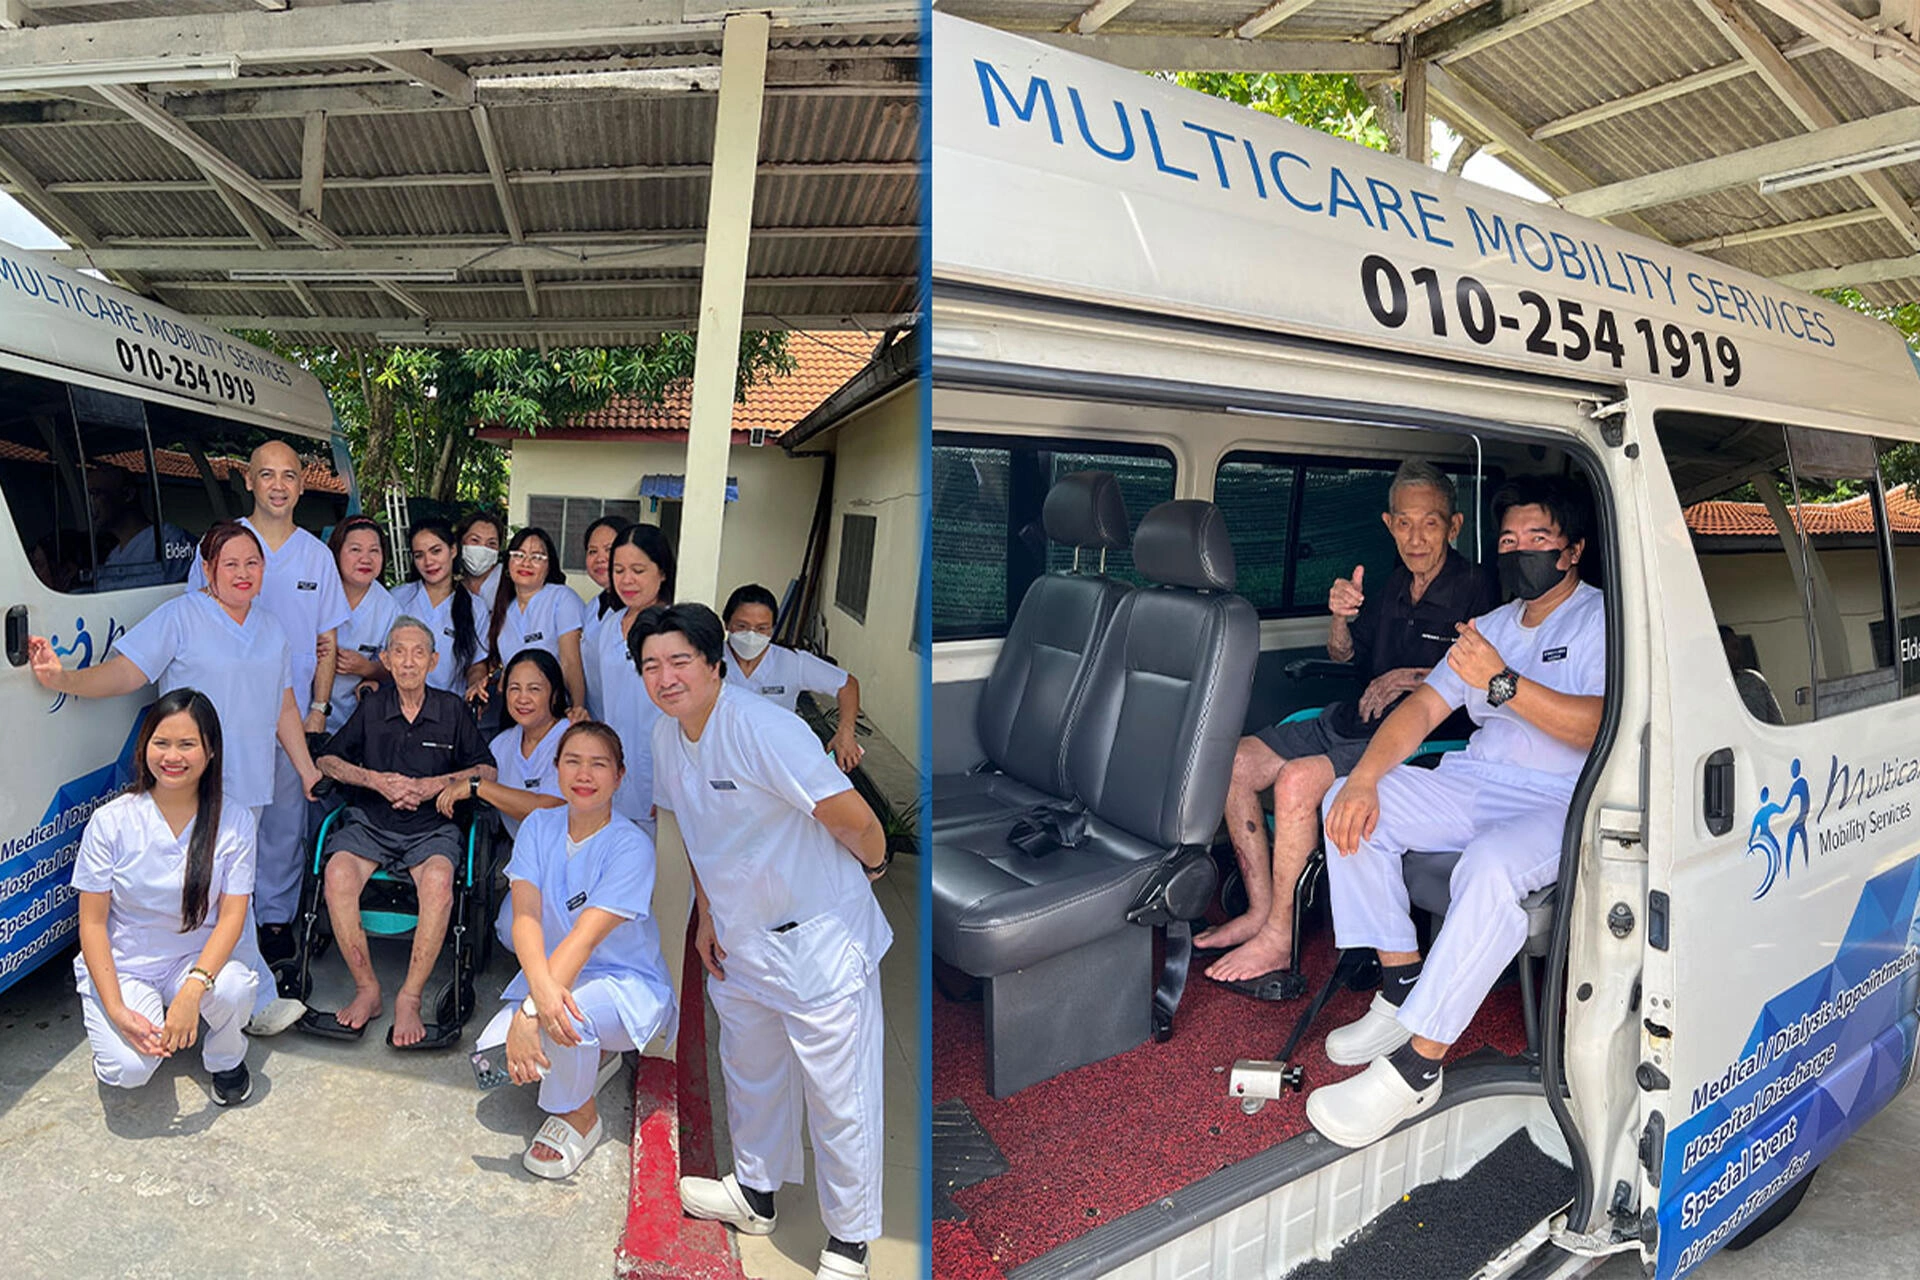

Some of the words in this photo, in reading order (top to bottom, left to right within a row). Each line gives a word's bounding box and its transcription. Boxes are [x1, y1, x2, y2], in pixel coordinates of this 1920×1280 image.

[974, 59, 1454, 248] MULTICARE
[1465, 206, 1676, 305] MOBILITY
[1688, 272, 1836, 347] SERVICES
[0, 257, 143, 334] MULTICARE
[143, 312, 226, 361] MOBILITY
[228, 344, 292, 386] SERVICES
[116, 337, 210, 394] 010-254
[212, 369, 255, 405] 1919
[1361, 254, 1625, 368] 010-254
[1634, 318, 1741, 387] 1919
[1901, 636, 1920, 661] Eld
[0, 814, 60, 864] Medical
[1817, 755, 1920, 824] Multica
[1819, 819, 1866, 856] Mobility
[1869, 802, 1911, 834] Services
[50, 912, 79, 943] Tran
[1690, 1042, 1763, 1115] Medical
[1773, 1001, 1834, 1063] Dialysis
[1832, 945, 1917, 1019] Appointment
[1682, 1091, 1761, 1174] Hospital
[1761, 1043, 1836, 1113] Discharge
[1672, 1206, 1744, 1280] Airport
[1743, 1150, 1811, 1220] Transfer
[1681, 1148, 1748, 1229] Special
[1750, 1116, 1797, 1174] Event
